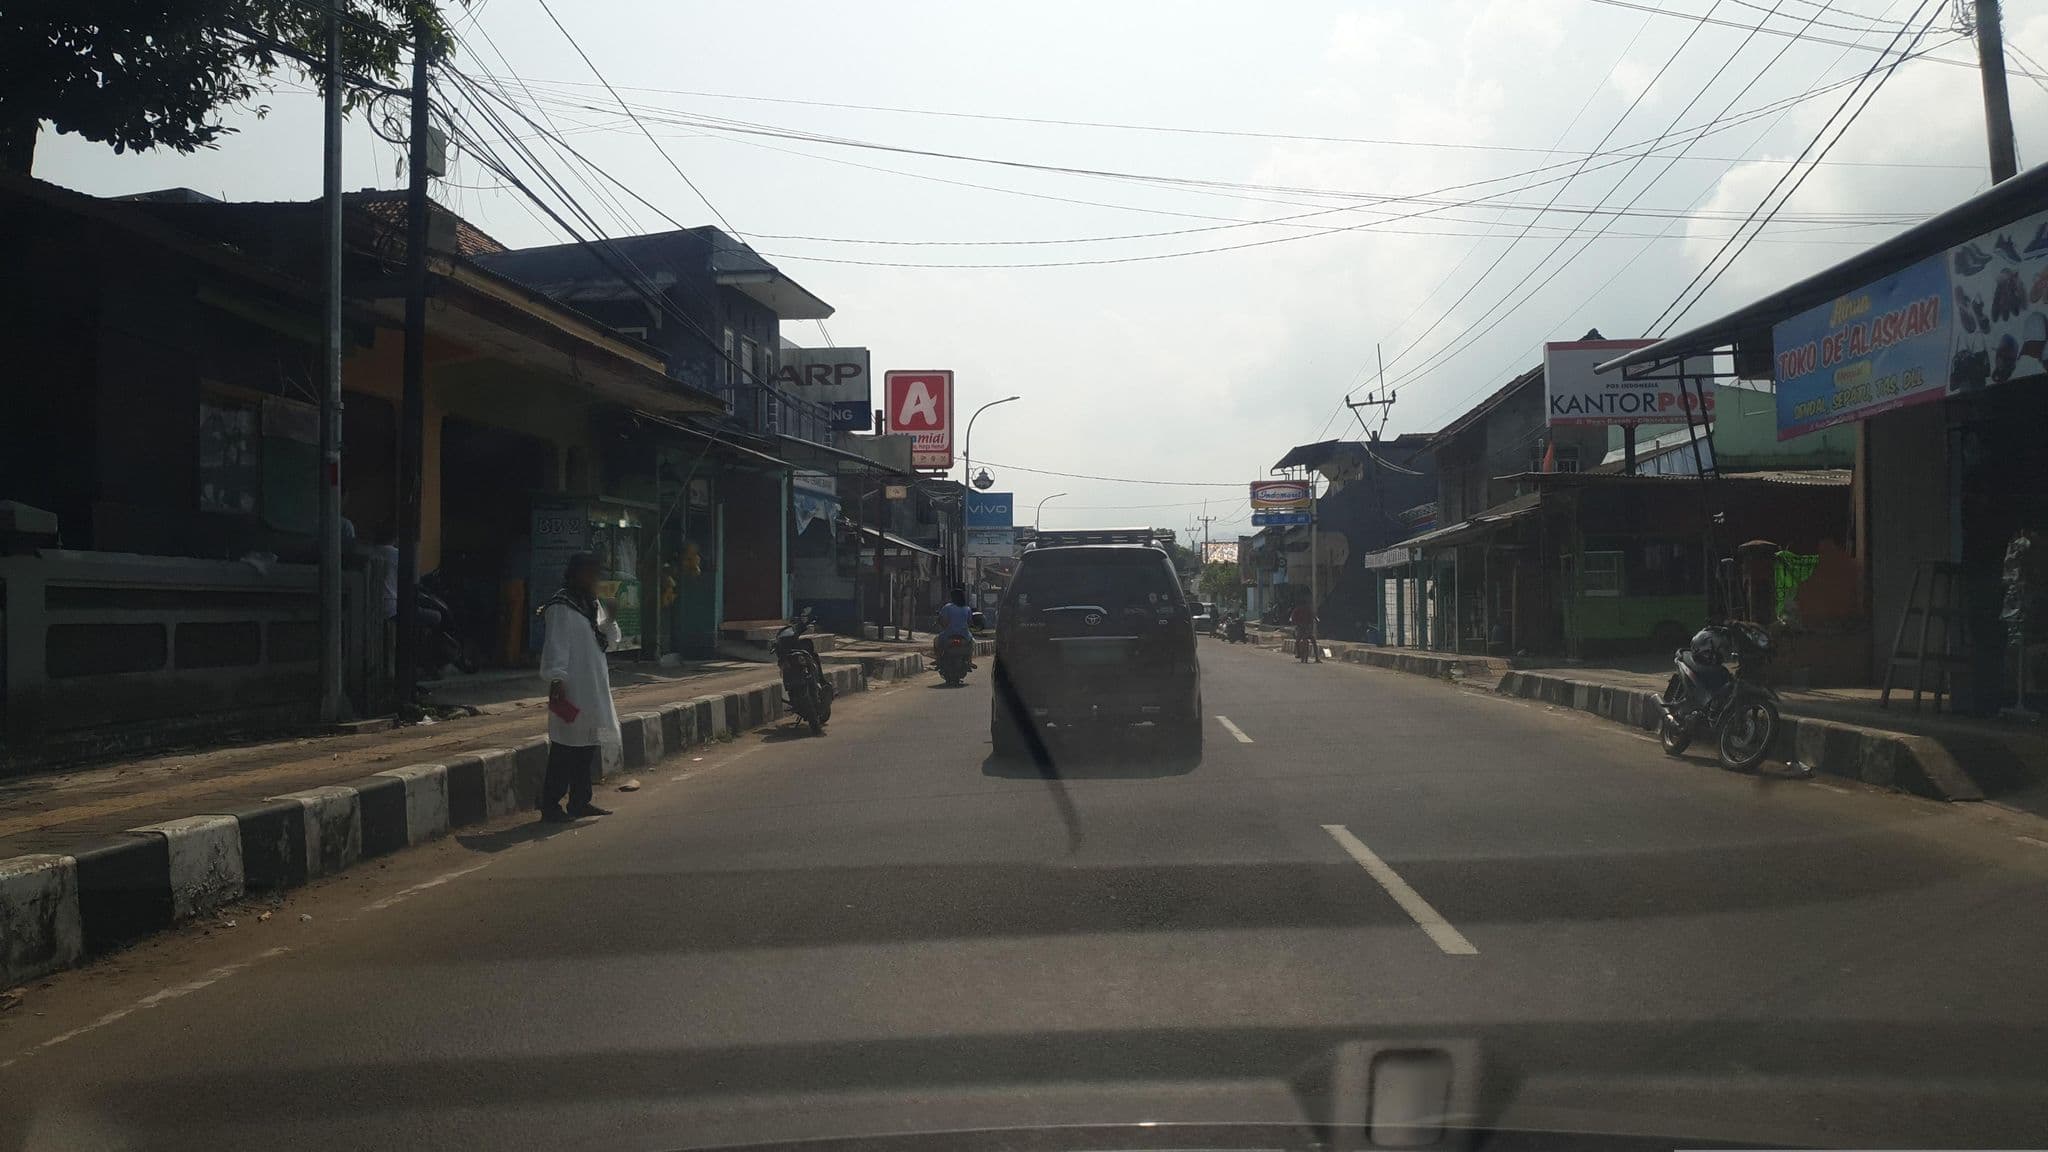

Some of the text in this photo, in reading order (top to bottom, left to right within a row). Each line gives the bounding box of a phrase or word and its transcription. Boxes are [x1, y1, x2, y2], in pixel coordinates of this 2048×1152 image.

[1778, 341, 1816, 382] TOKO
[900, 433, 944, 444] amidi
[1259, 490, 1301, 499] Indomaret
[968, 502, 1007, 513] vivo
